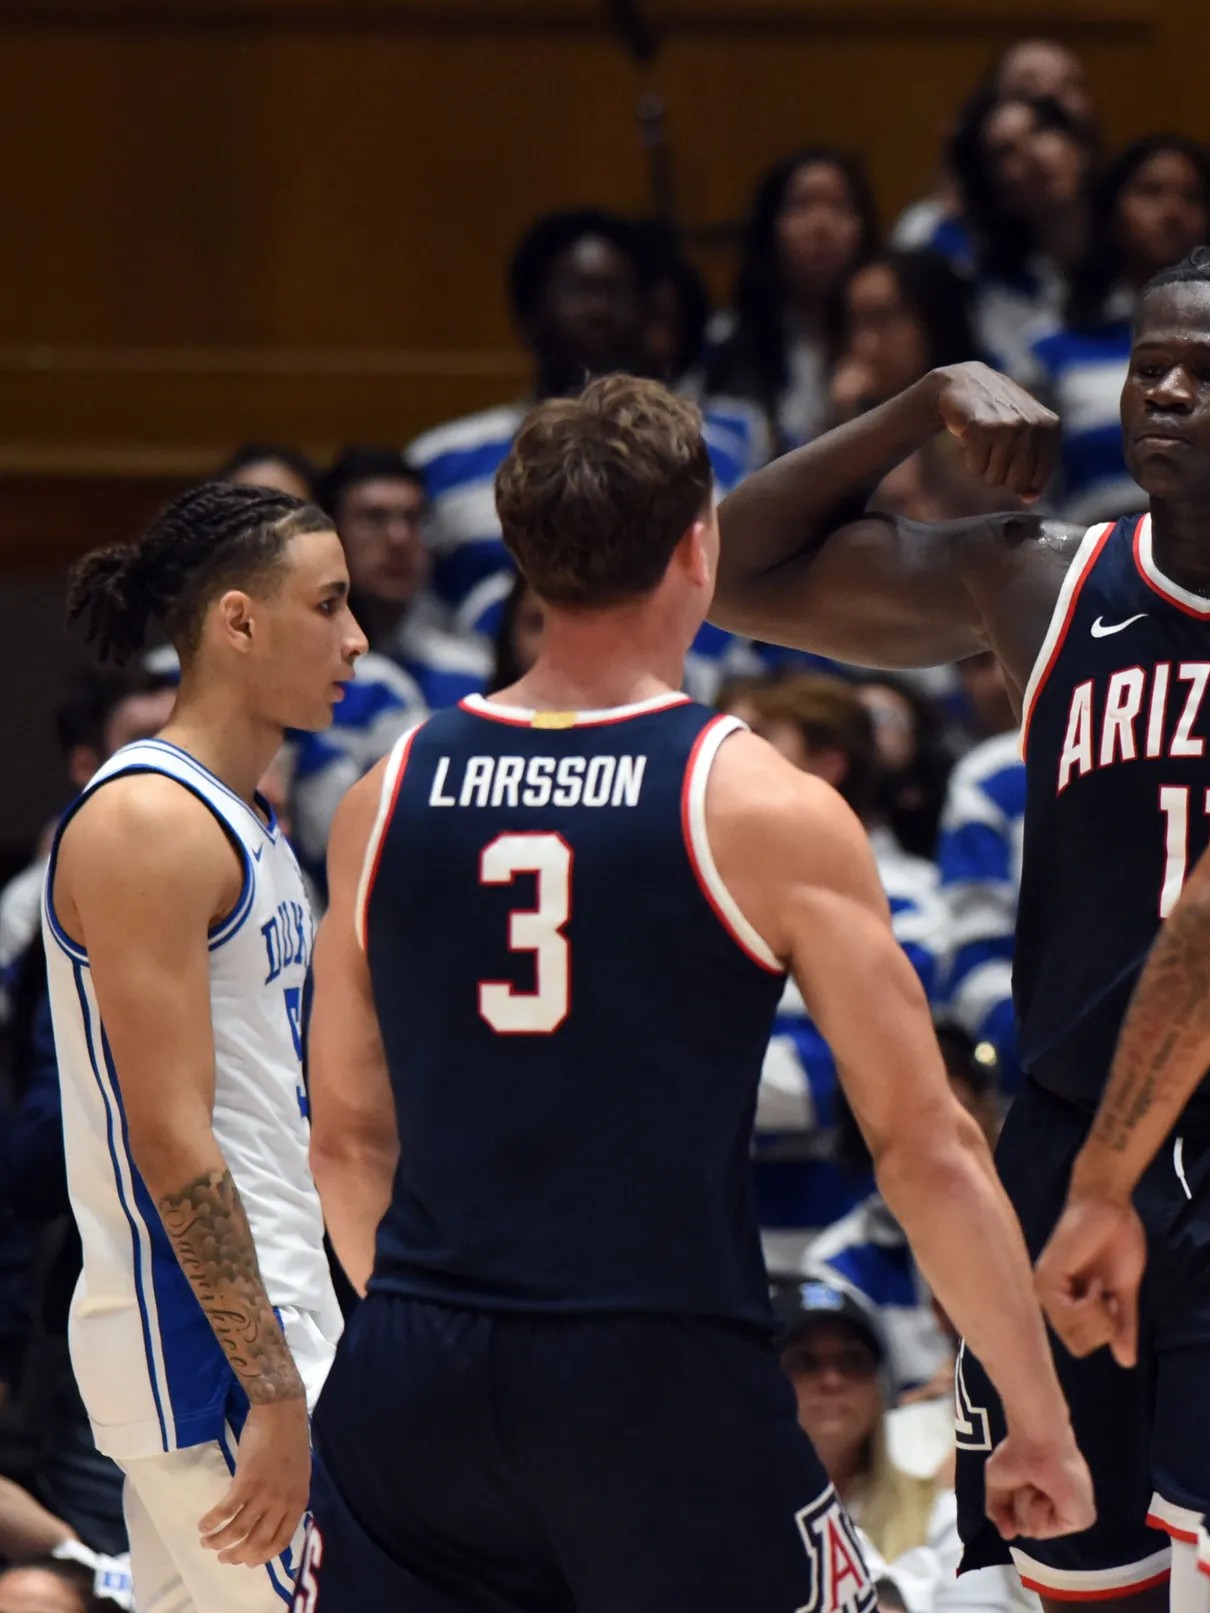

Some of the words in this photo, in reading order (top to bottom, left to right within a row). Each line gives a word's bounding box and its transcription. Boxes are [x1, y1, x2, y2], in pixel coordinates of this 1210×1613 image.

[429, 755, 648, 808] LARSSON
[261, 901, 314, 986] DUK
[478, 830, 575, 1035] 3
